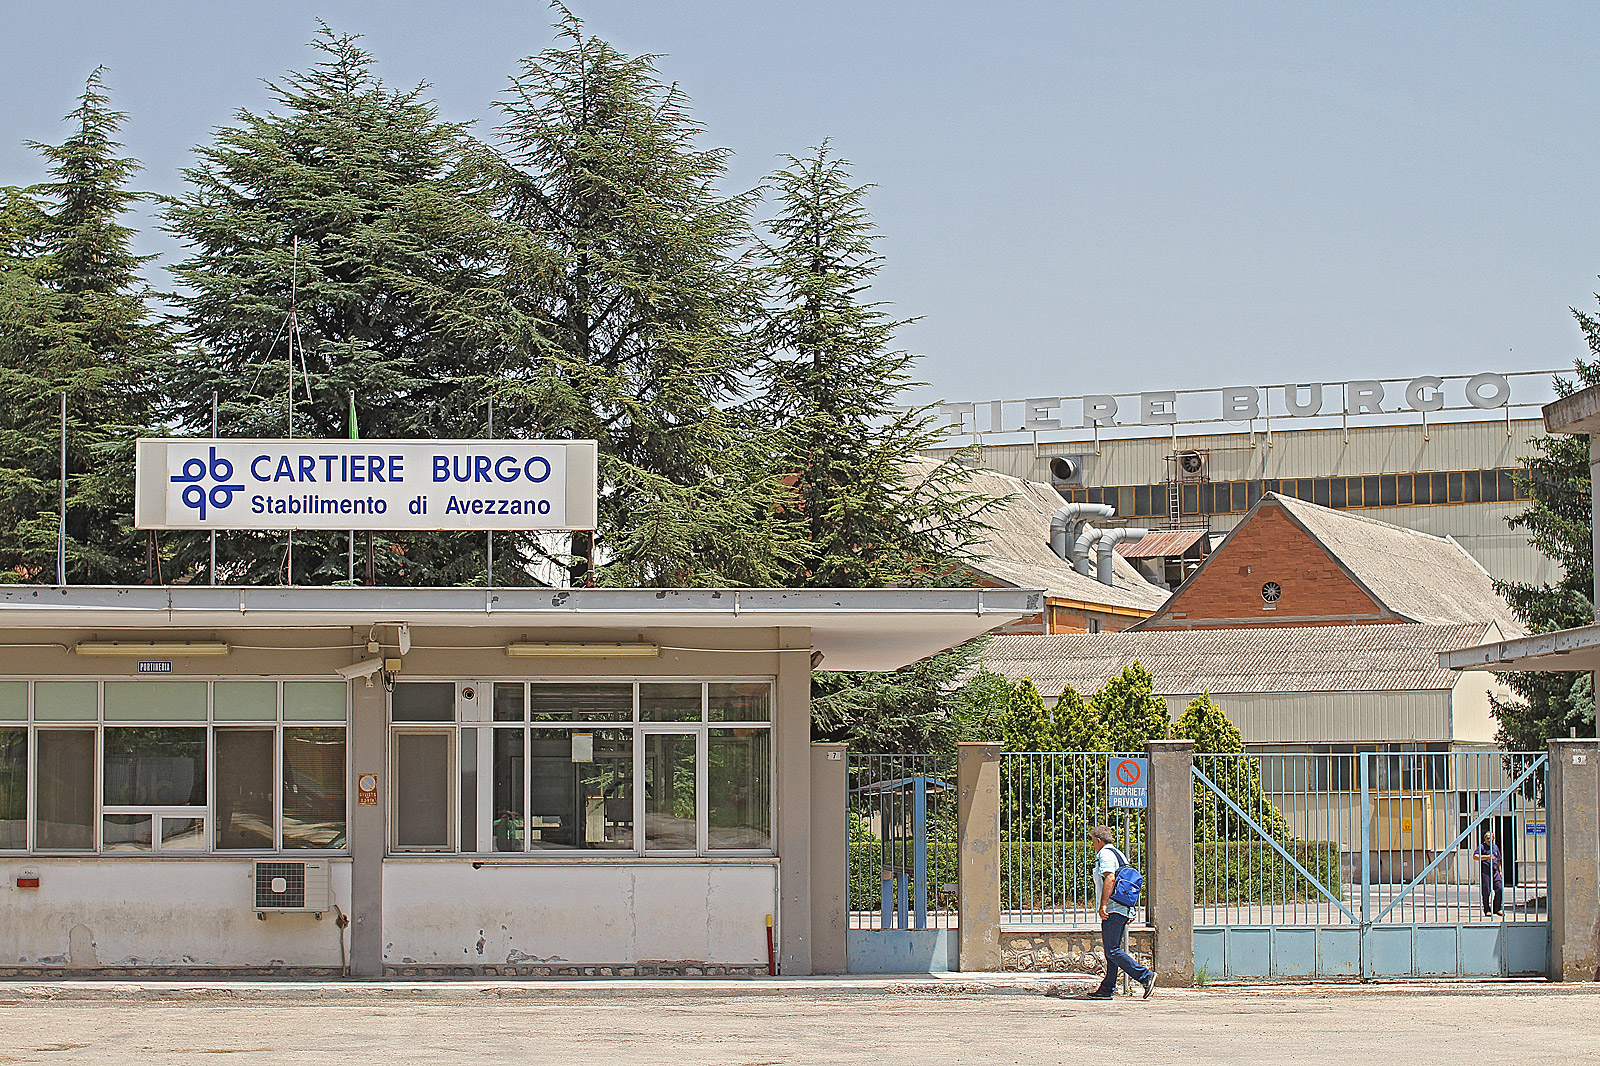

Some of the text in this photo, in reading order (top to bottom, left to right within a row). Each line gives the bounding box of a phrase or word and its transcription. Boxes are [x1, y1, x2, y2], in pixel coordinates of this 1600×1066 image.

[1222, 372, 1511, 421] BURGO
[250, 456, 551, 483] CARTIERE BURGO
[251, 494, 550, 515] Stabilimento di Avezzano
[1113, 797, 1144, 807] PRIVATA
